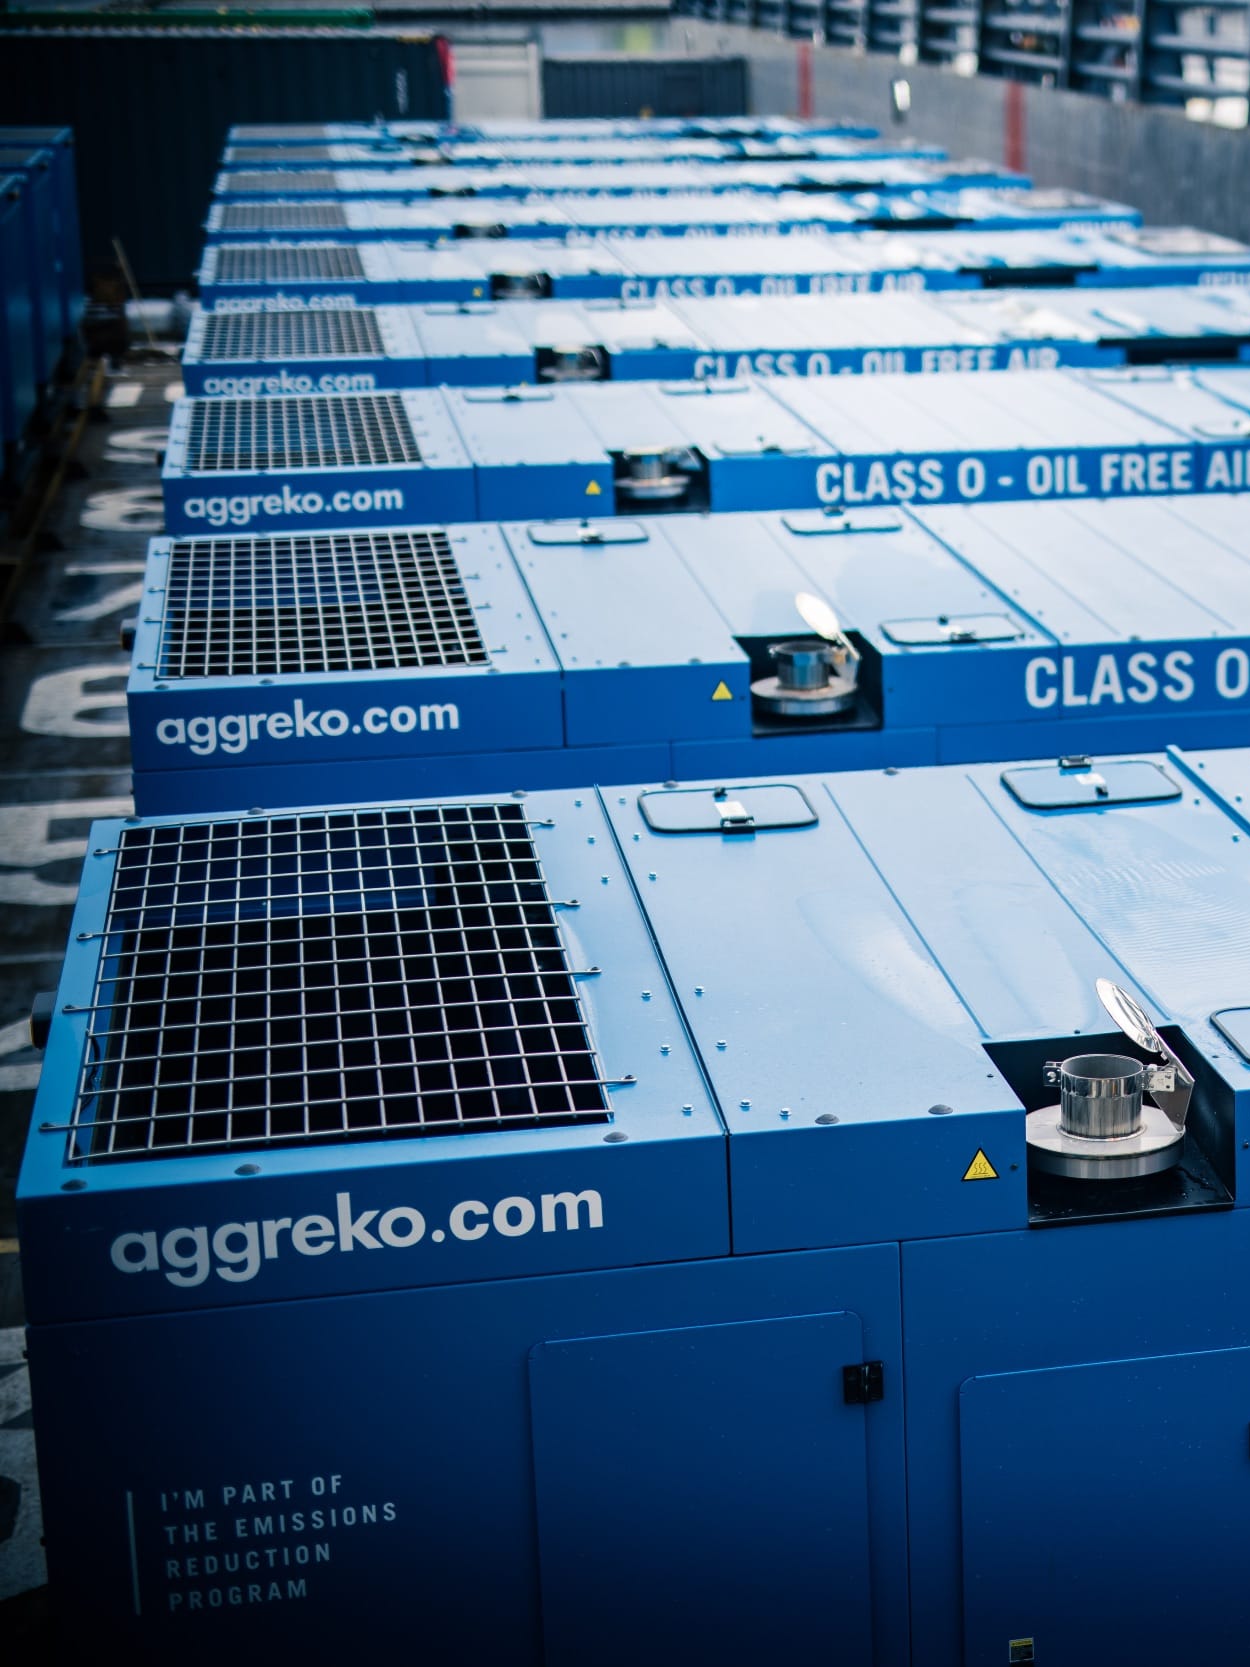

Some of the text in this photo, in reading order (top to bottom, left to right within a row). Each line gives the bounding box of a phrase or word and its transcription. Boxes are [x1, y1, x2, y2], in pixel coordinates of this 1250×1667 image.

[203, 369, 376, 396] aggreko.com
[815, 460, 943, 502] CLASS
[1027, 455, 1087, 495] OIL
[1101, 452, 1192, 491] FREE
[184, 485, 404, 527] aggreko.com
[1025, 651, 1195, 708] CLASS
[156, 698, 460, 755] aggreko.com
[110, 1188, 604, 1288] aggreko.com
[160, 1475, 342, 1511] I'M PART OF
[165, 1502, 397, 1545] THE EMISSIONS
[167, 1543, 330, 1579] REDUCTION
[169, 1578, 308, 1612] PROGRAM
